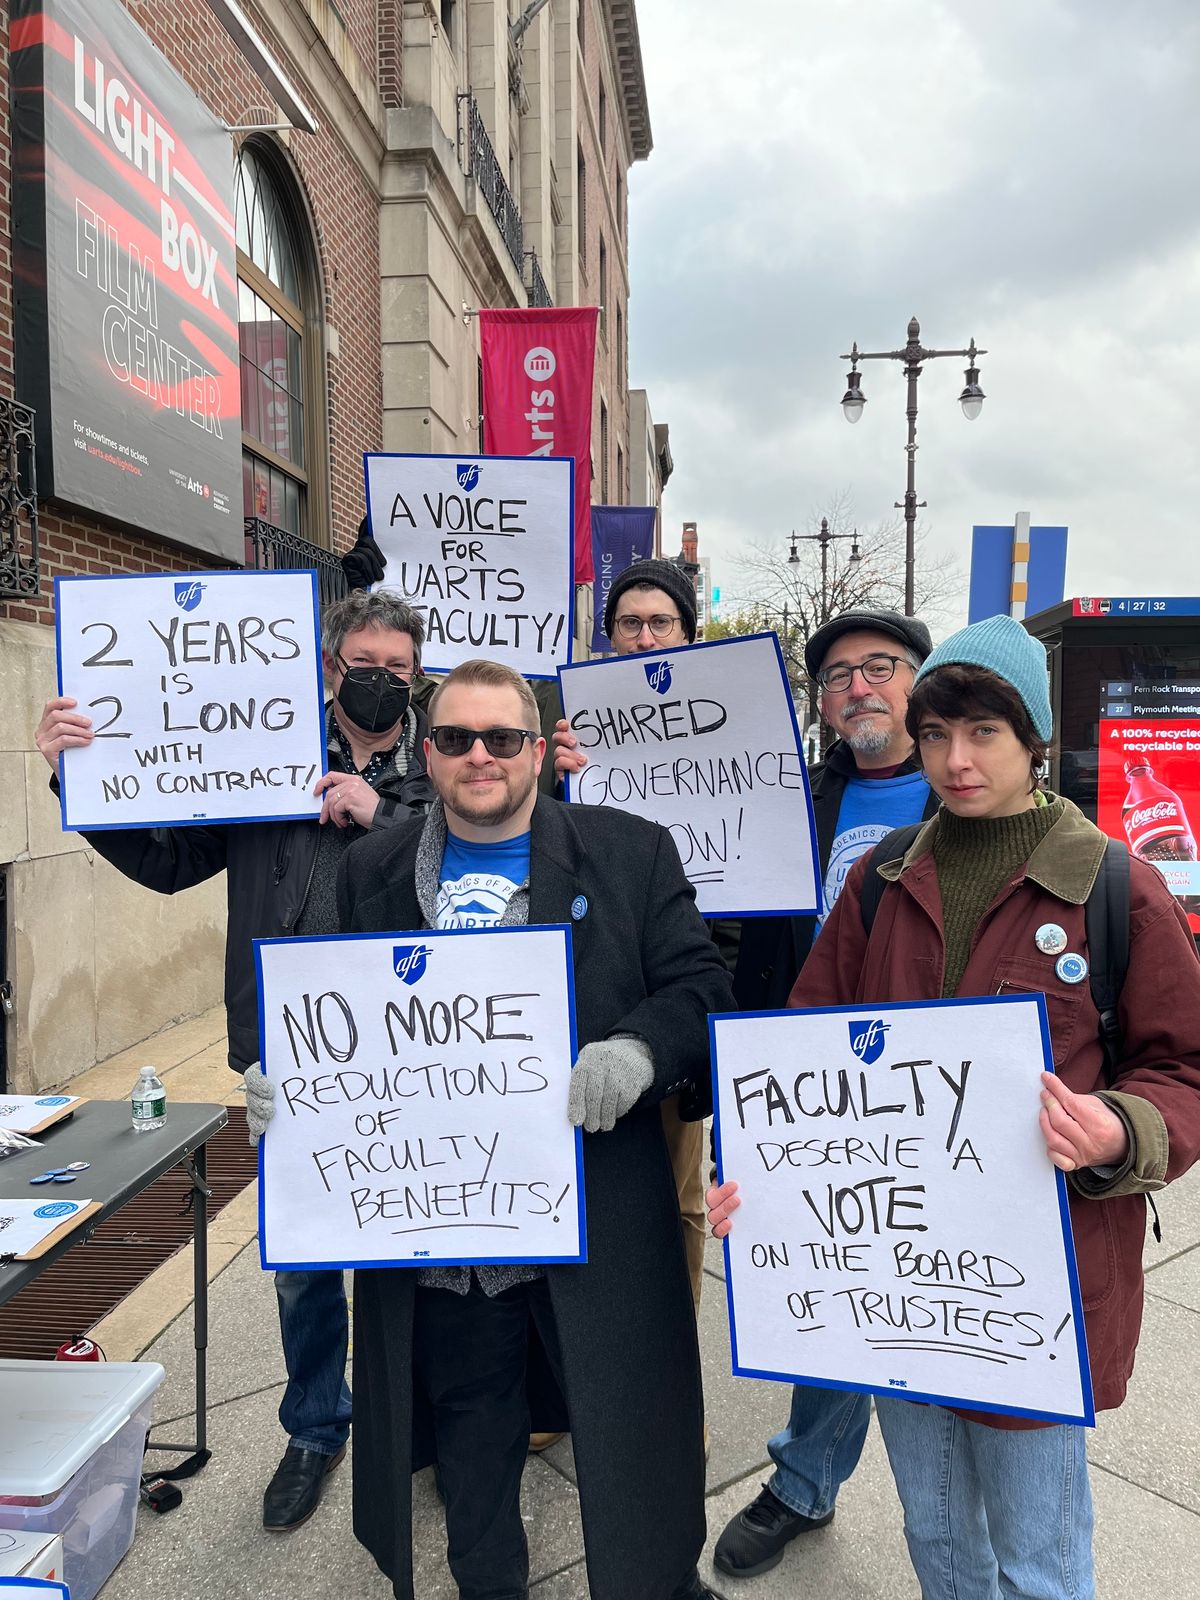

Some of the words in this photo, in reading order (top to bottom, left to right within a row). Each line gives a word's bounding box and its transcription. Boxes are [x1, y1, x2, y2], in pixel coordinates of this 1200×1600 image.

[76, 197, 158, 330] FILM
[161, 198, 220, 310] BOX
[102, 304, 223, 440] CENTER
[73, 420, 84, 434] For
[86, 427, 118, 450] showtimes
[119, 444, 130, 456] and
[74, 437, 87, 451] visit
[188, 477, 203, 496] Arts
[389, 492, 417, 528] A
[423, 492, 528, 533] VOICE
[441, 540, 487, 563] FOR
[401, 562, 525, 602] UARTS
[1118, 602, 1125, 610] 4
[1133, 602, 1145, 610] 27
[1153, 602, 1166, 610] 32
[81, 622, 134, 666] 2
[148, 616, 300, 667] YEARS
[411, 605, 566, 655] ACULTY!
[161, 672, 194, 694] IS
[1134, 685, 1151, 693] Fern
[1152, 685, 1170, 693] Rock
[1171, 685, 1200, 695] Transpo
[88, 696, 134, 738] 2
[163, 698, 295, 733] LONG
[571, 699, 727, 749] SHARED
[1133, 705, 1170, 715] Plymouth
[1110, 728, 1120, 738] A
[1121, 728, 1153, 738] 100%
[1123, 741, 1183, 753] recyclable
[134, 742, 203, 768] WITH
[102, 775, 140, 803] NO
[156, 764, 317, 794] CONTRACT!
[579, 751, 802, 806] GOVERNANCE
[655, 805, 744, 867] OW!
[283, 991, 358, 1068] NO
[385, 993, 540, 1056] MORE
[281, 1056, 549, 1116] REDUCTIONS
[732, 1060, 972, 1152] FACULTY
[355, 1108, 402, 1137] OF
[312, 1132, 500, 1192] FACULTY
[756, 1133, 926, 1172] DESERVE
[952, 1138, 984, 1173] A
[350, 1180, 571, 1229] BENEFITS!
[802, 1176, 929, 1239] VOTE
[751, 1242, 789, 1270] ON
[800, 1242, 872, 1272] THE
[893, 1241, 1026, 1288] BOARD
[787, 1290, 825, 1321] OF
[833, 1287, 1072, 1361] TRUSTEES!
